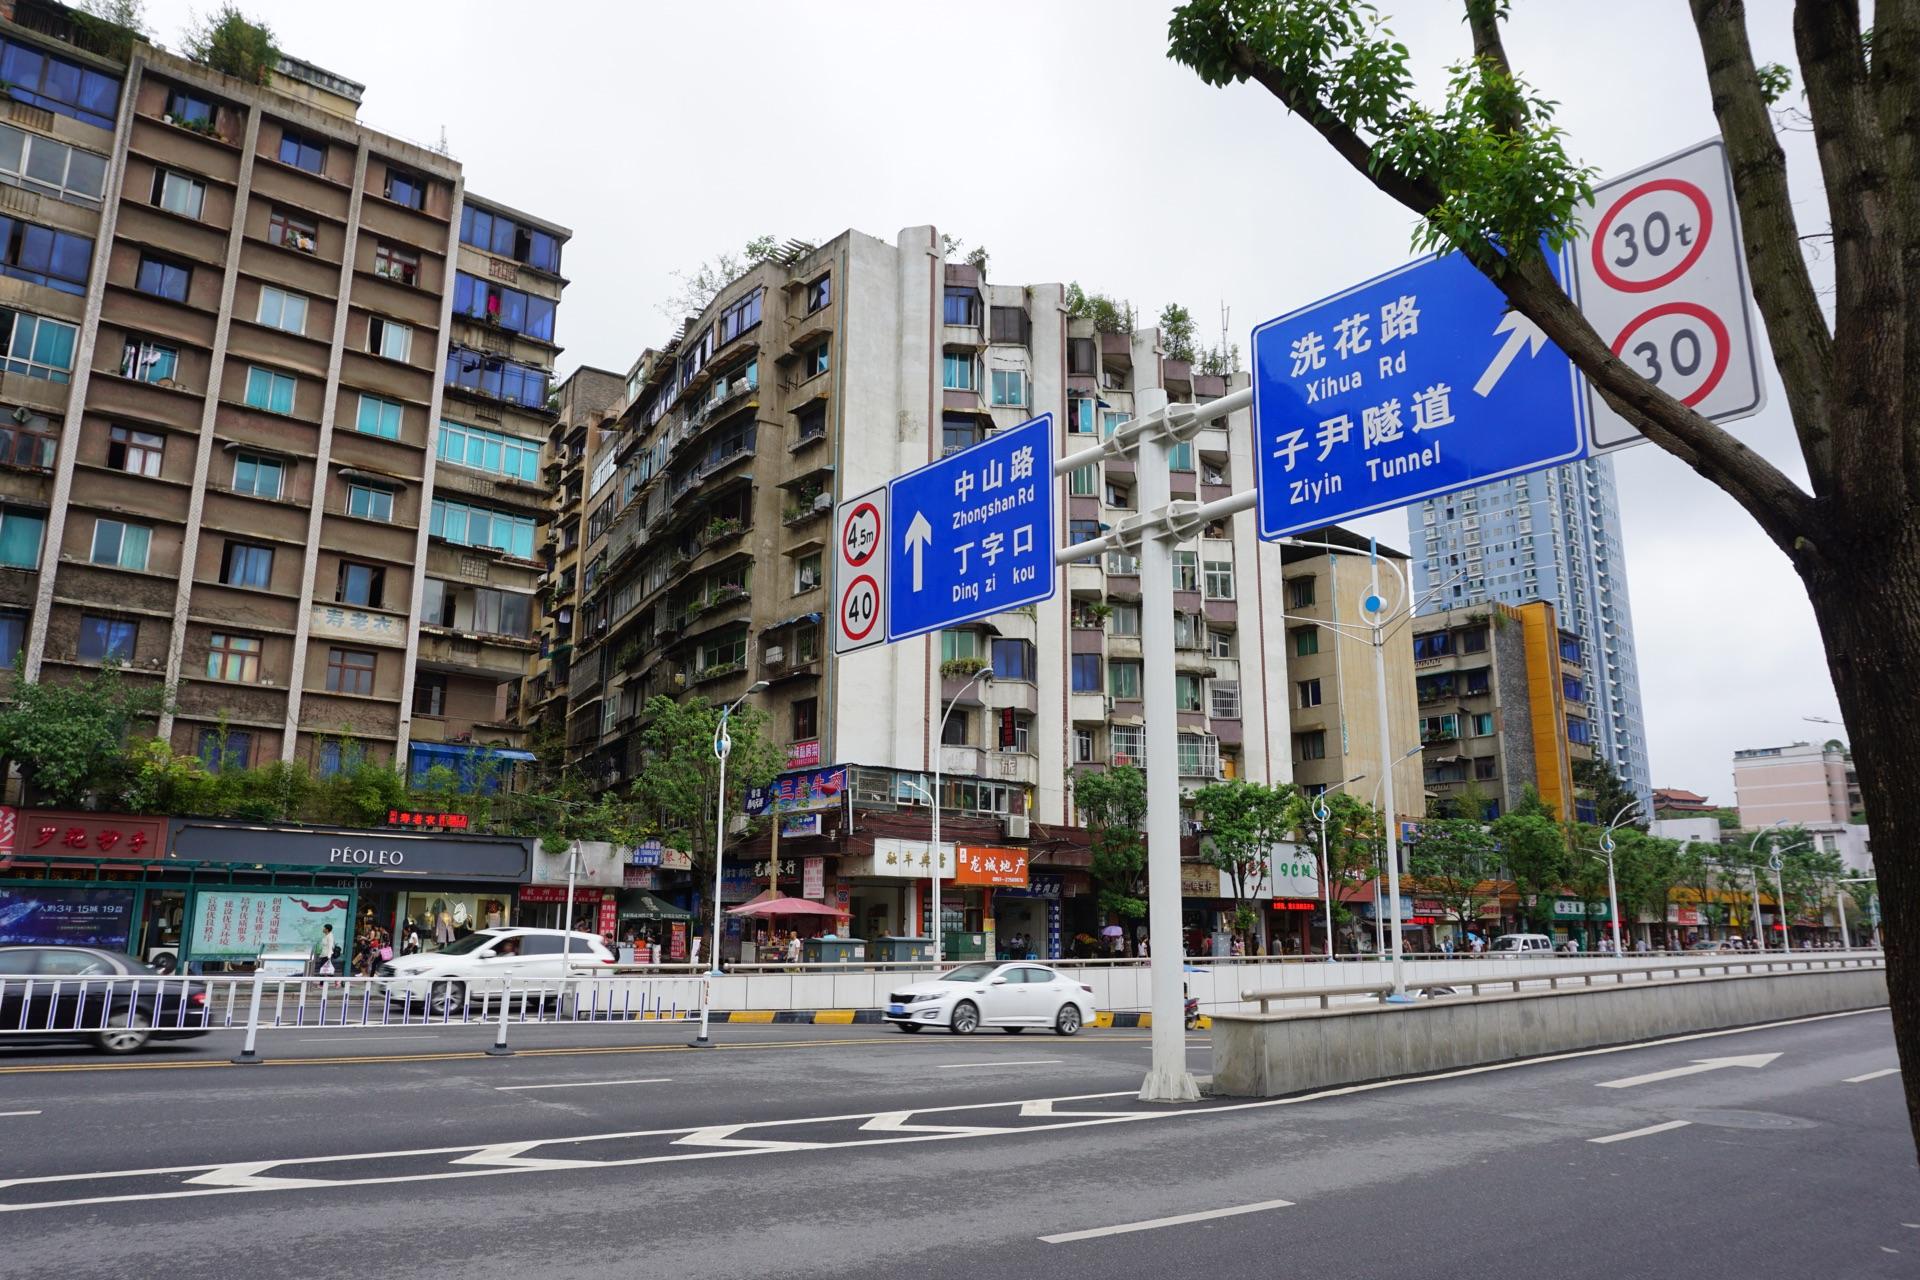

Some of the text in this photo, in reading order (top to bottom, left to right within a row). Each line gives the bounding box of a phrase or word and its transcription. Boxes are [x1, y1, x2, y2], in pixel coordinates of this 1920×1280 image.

[1613, 210, 1693, 269] 30t
[1289, 294, 1422, 378] 洗花路
[1632, 328, 1702, 385] 30
[1306, 351, 1407, 405] Xihua Rd
[1273, 382, 1456, 473] 子尹隧道
[955, 445, 1034, 502] 中山路
[1289, 441, 1441, 505] Ziyin Tunnel
[952, 485, 1035, 530] Zhongshan Rd
[847, 522, 874, 549] 4.5m
[953, 524, 1033, 576] 丁字口
[848, 592, 872, 623] 40
[952, 565, 1035, 603] Ding zi kou
[330, 847, 404, 866] PÉOLEO
[970, 855, 1026, 875] 龙城地产
